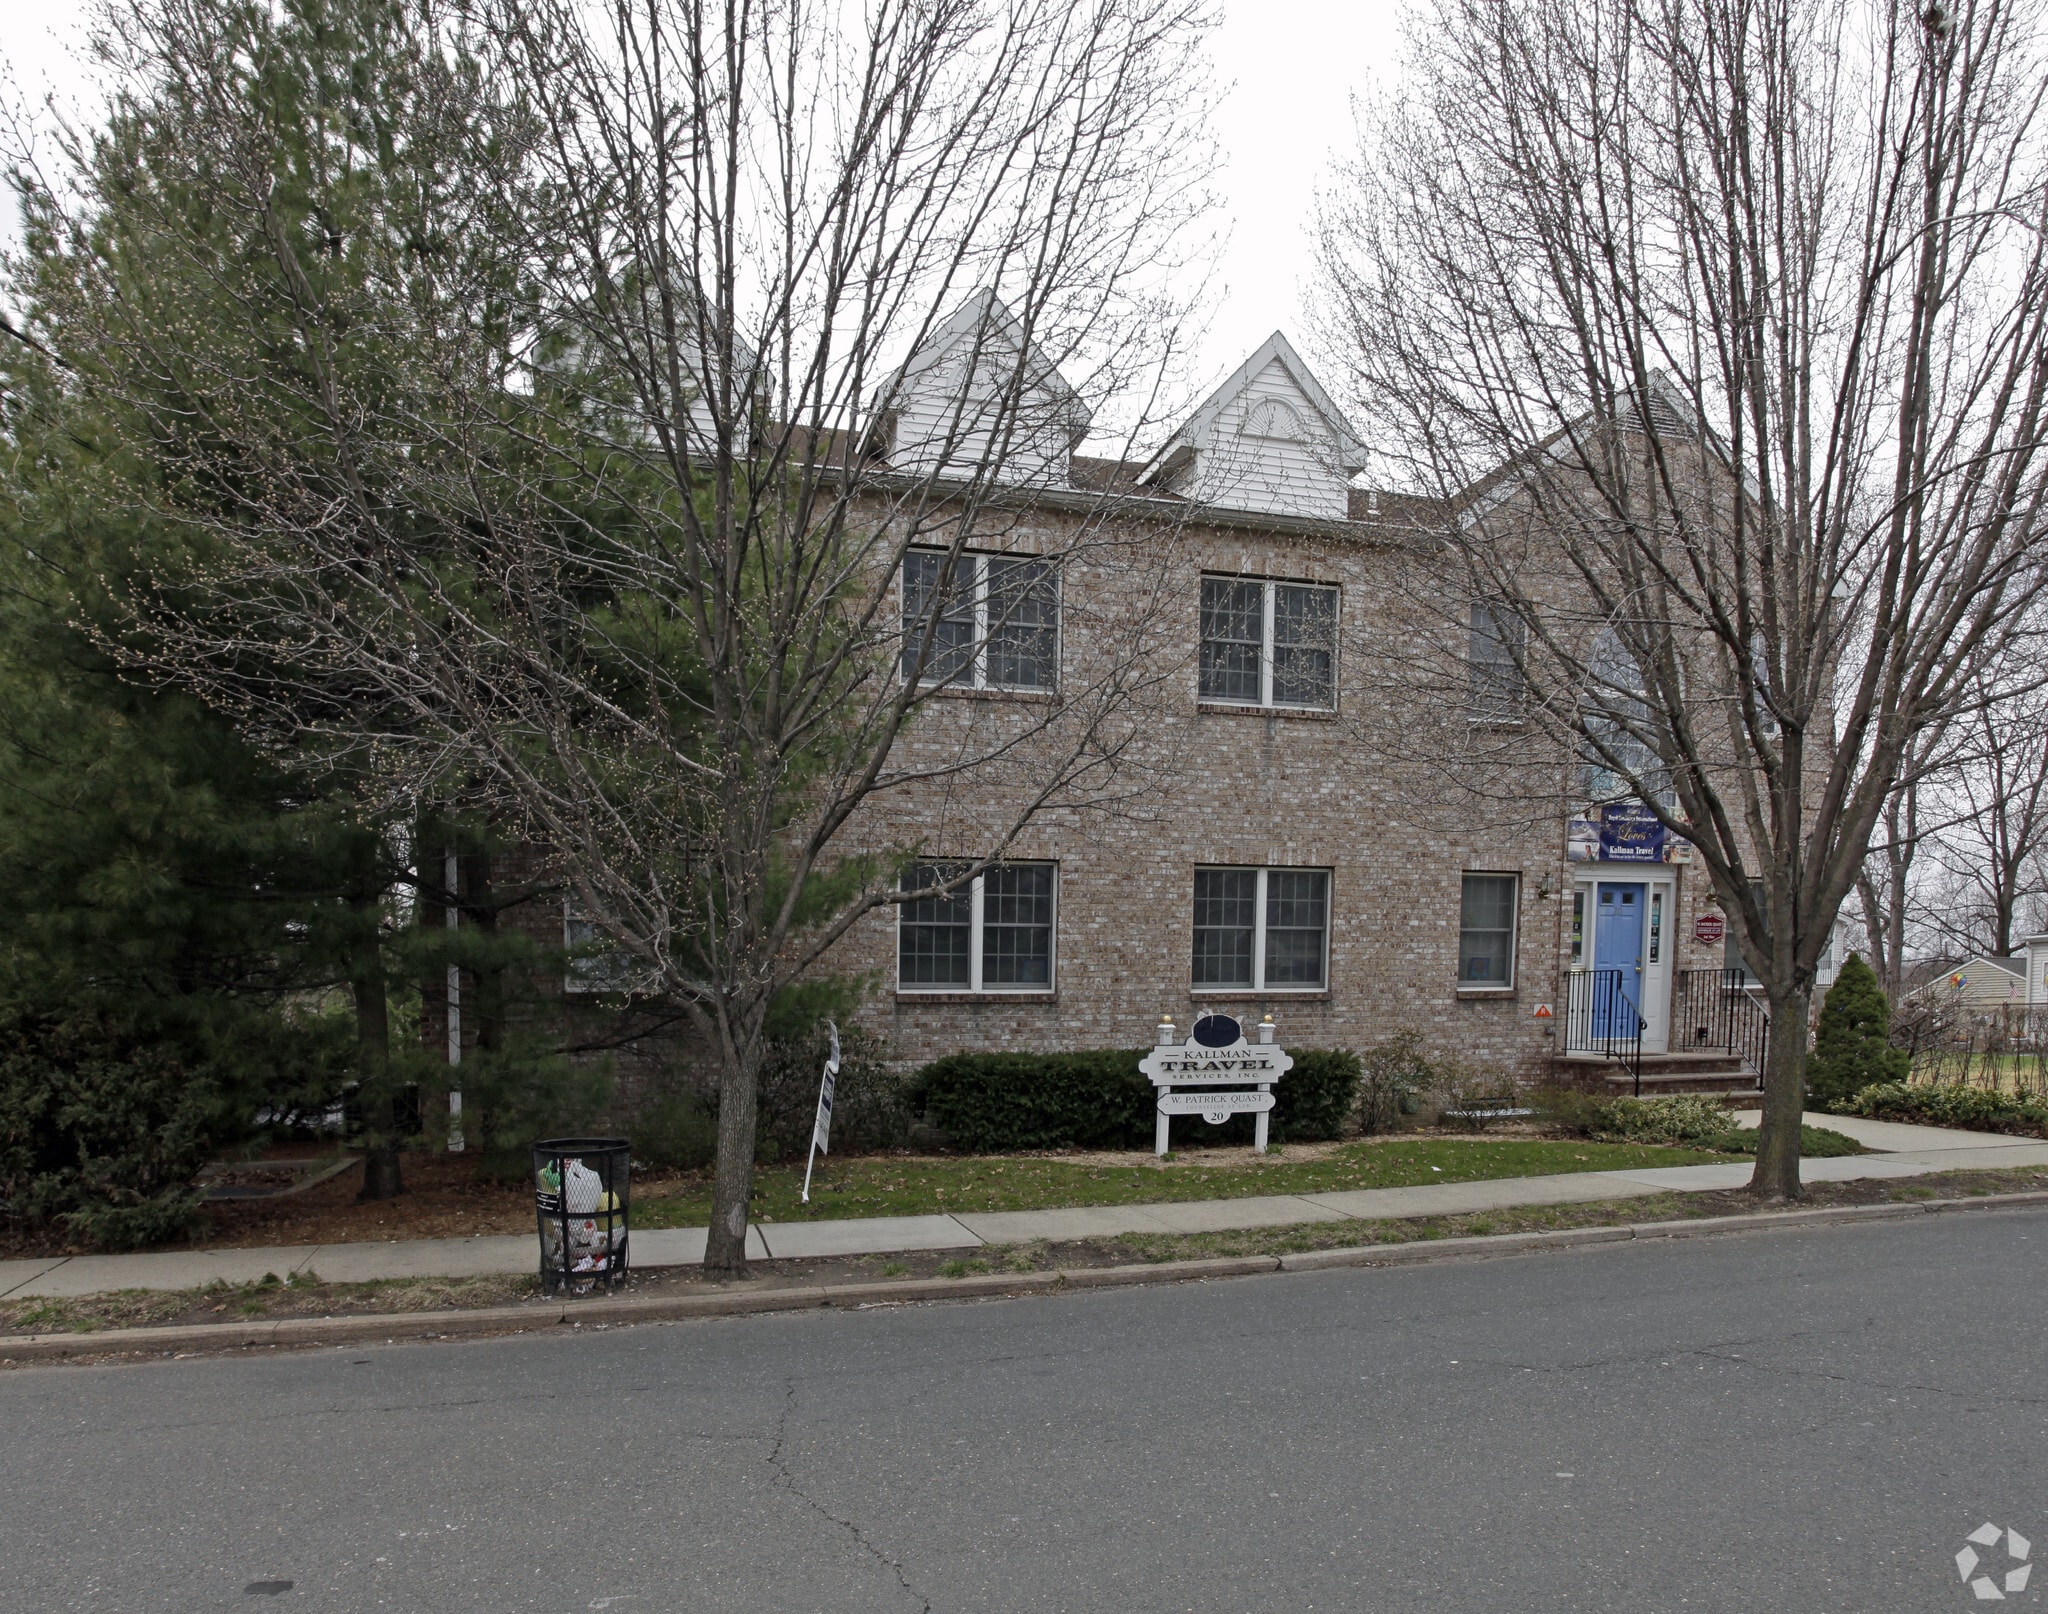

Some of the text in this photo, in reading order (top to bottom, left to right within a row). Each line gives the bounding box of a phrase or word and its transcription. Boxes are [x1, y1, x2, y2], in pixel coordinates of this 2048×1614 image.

[1610, 845, 1654, 854] Kallman Travel
[1184, 1050, 1251, 1059] KALLMAN
[1161, 1060, 1275, 1072] TRAVEL
[1171, 1094, 1264, 1104] W. PATRICK QUAST
[1211, 1112, 1224, 1121] 20
